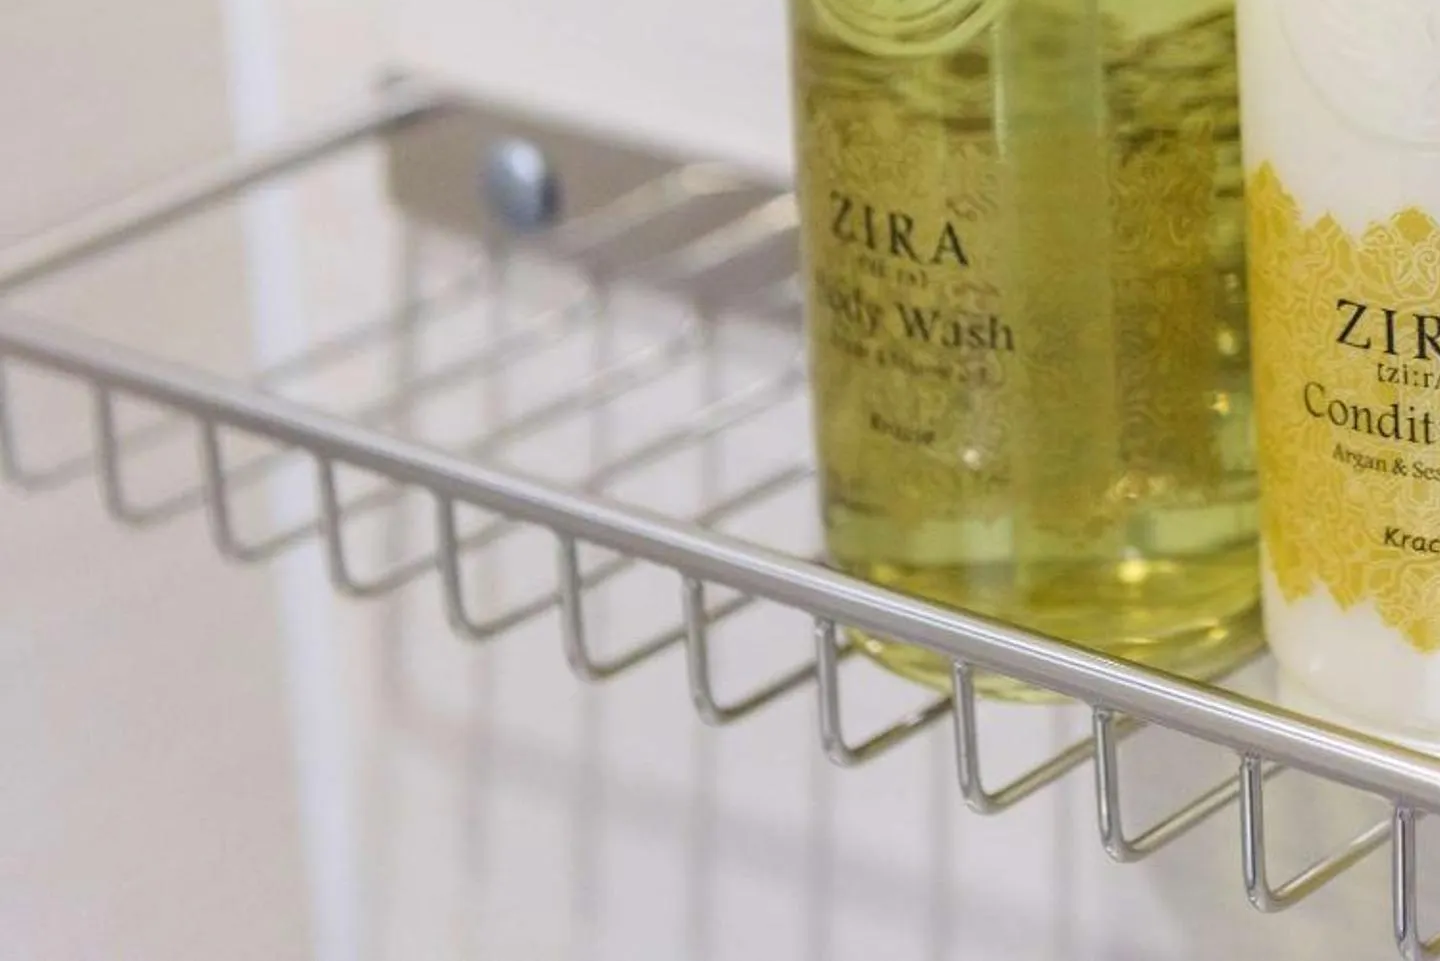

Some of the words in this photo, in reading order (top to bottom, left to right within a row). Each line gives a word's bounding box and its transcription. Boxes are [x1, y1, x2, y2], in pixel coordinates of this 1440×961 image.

[829, 190, 969, 267] ZIRA
[895, 301, 1015, 352] Wash
[1332, 443, 1387, 474] Argan
[1391, 457, 1408, 477] &
